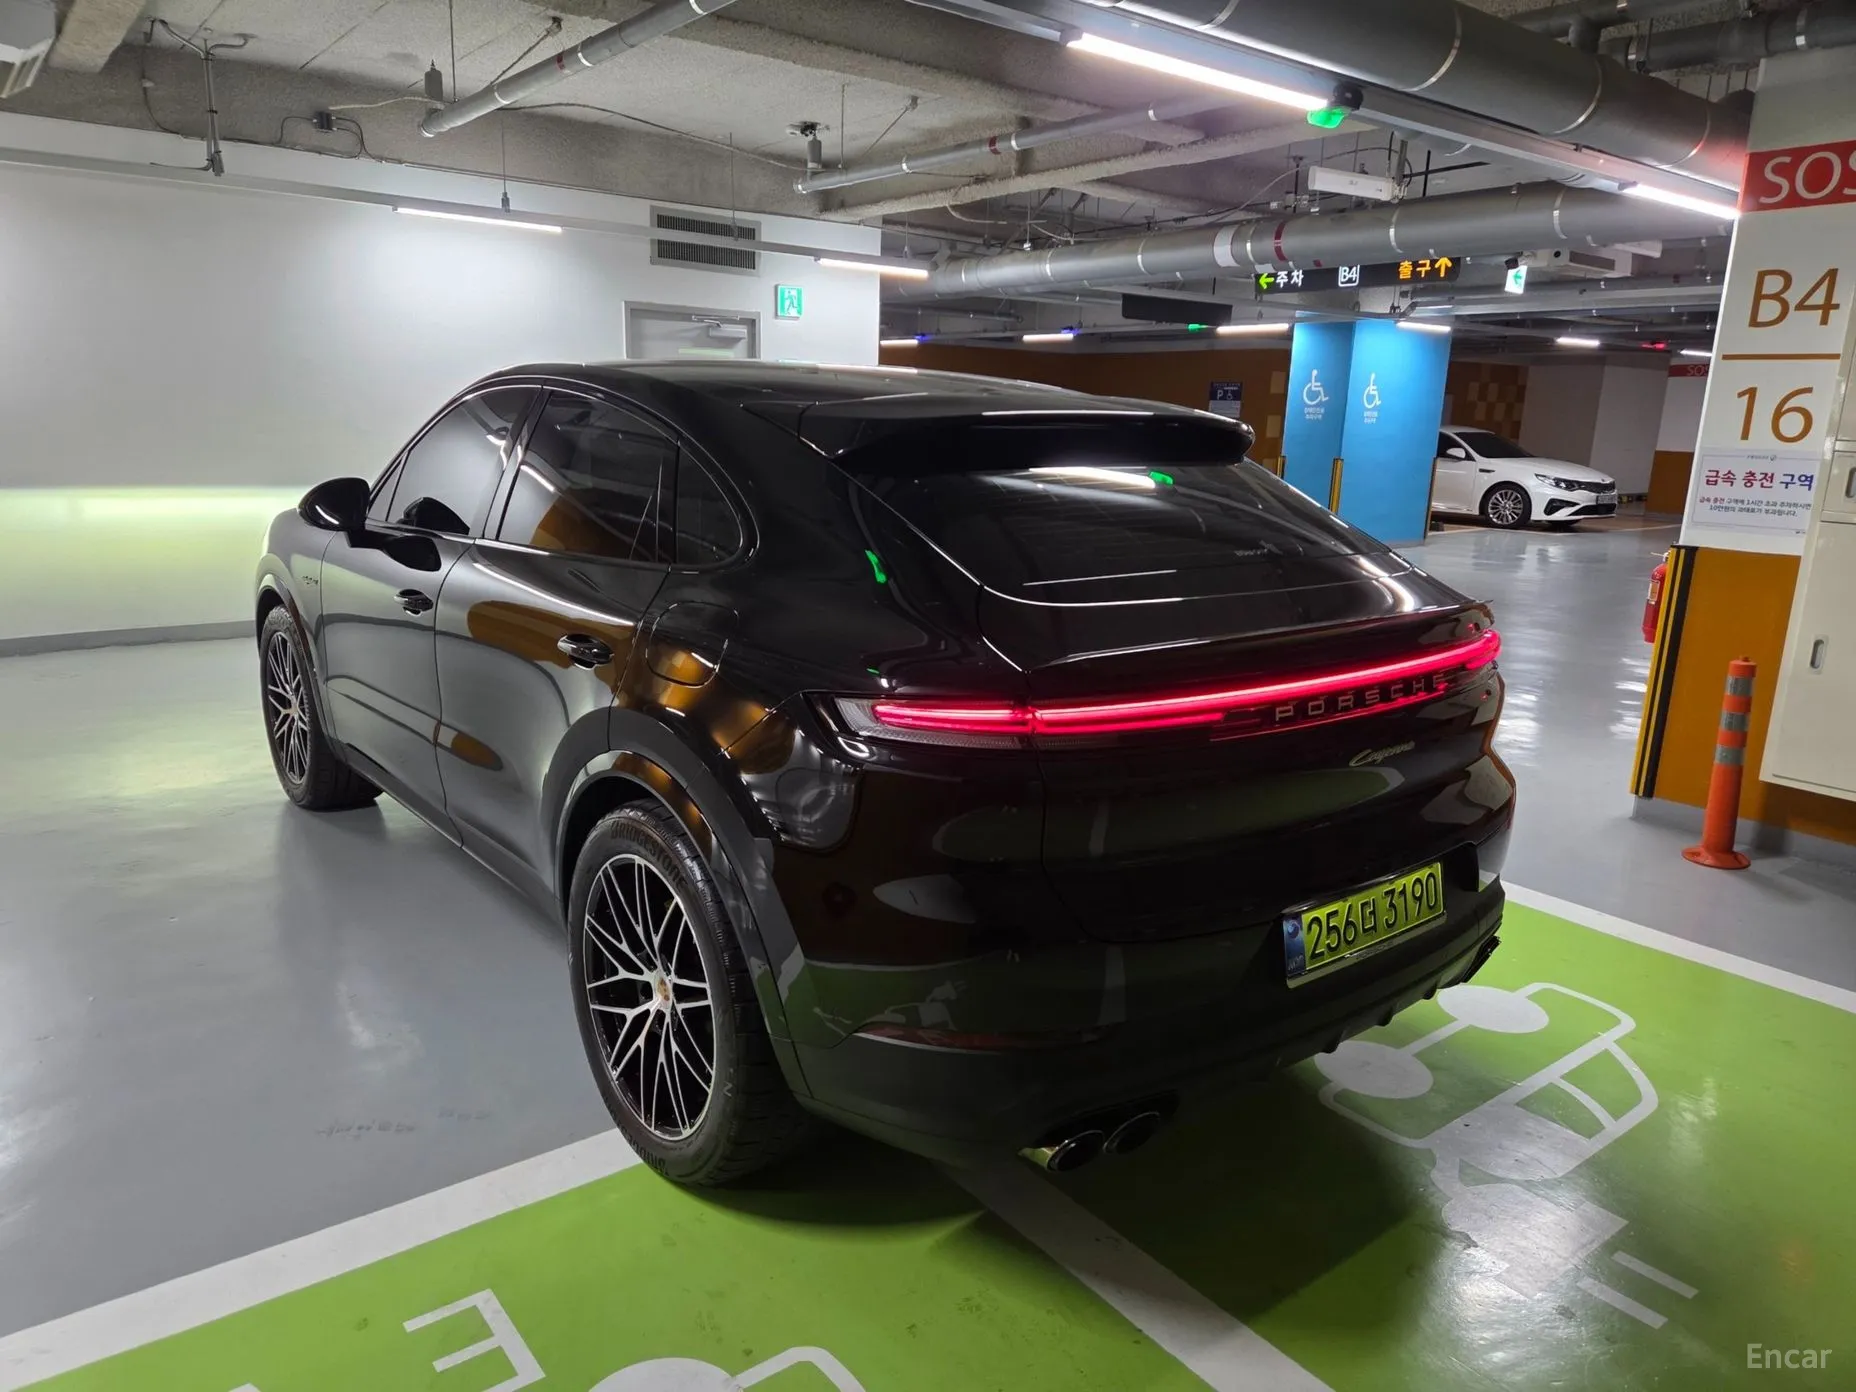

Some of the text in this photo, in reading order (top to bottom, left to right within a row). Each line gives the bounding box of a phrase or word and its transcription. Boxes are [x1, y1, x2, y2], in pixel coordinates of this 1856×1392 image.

[1276, 269, 1304, 288] 주차
[1340, 265, 1358, 282] B4
[1398, 260, 1431, 279] 출구
[1748, 267, 1840, 329] B4
[1686, 365, 1709, 376] SO
[1736, 385, 1814, 444] 16
[1705, 469, 1815, 491] 급속 충전 구역
[1275, 673, 1448, 722] PORSCHE
[610, 820, 688, 891] BRIDGESTONE
[1307, 871, 1438, 961] 256더 3190
